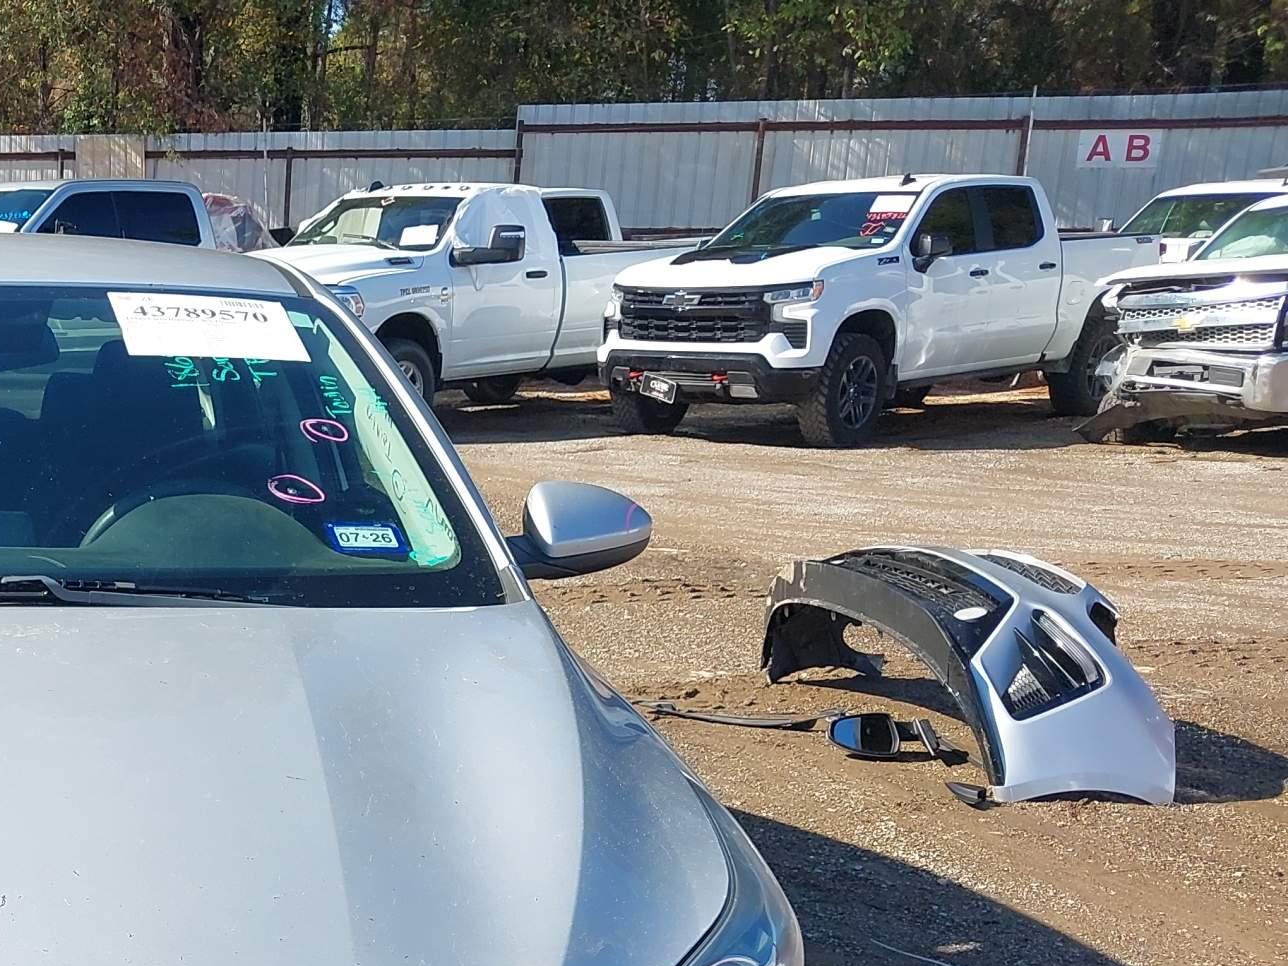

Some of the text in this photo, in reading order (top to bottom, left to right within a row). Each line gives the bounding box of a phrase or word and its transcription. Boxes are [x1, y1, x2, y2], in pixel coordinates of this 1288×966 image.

[1086, 134, 1151, 161] A B
[133, 306, 268, 323] 43789570
[338, 532, 393, 543] 07 26
